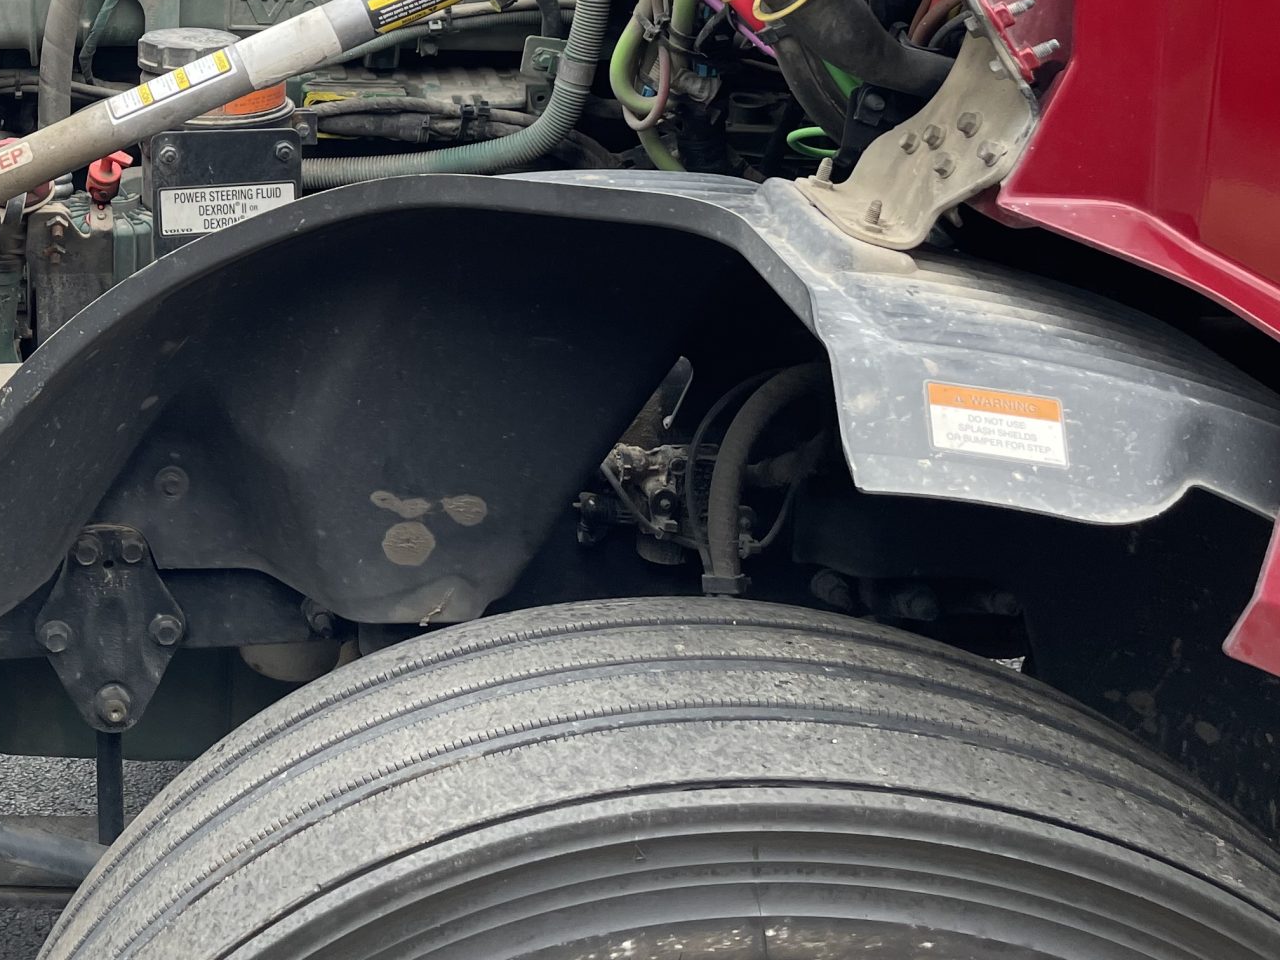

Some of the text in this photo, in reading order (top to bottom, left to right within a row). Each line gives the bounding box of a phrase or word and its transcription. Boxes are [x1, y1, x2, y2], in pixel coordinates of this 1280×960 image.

[174, 187, 281, 204] POWER STEERING FLUID
[241, 204, 247, 214] II
[970, 395, 1037, 413] WARNING
[968, 414, 1026, 429] DO NOT USE
[958, 423, 1038, 442] SPLASH SHIELDS
[946, 432, 961, 440] OR
[963, 434, 1003, 448] BUMPER
[1005, 440, 1025, 451] FOR
